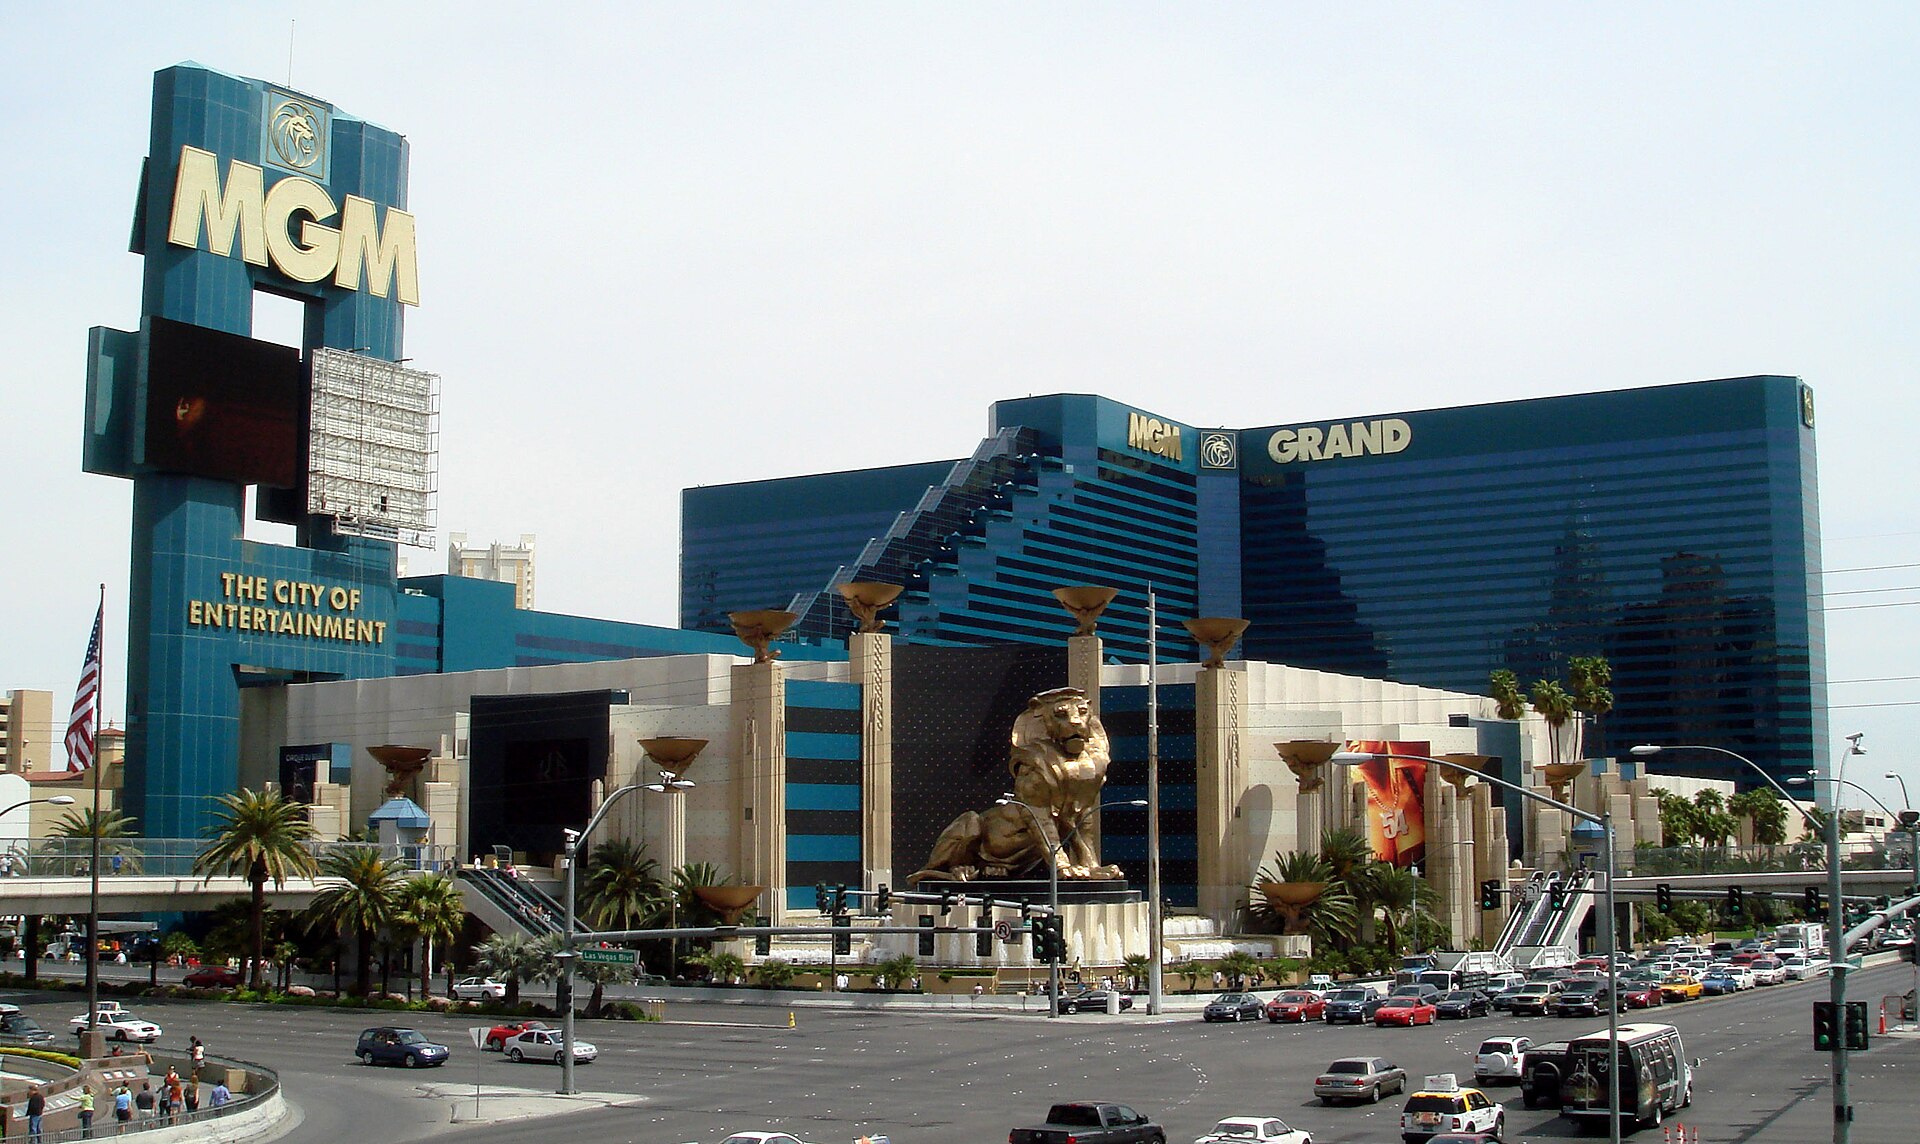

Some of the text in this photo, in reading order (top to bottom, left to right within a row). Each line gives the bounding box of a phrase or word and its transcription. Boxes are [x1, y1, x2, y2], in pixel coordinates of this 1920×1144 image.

[168, 145, 420, 307] MGM
[1128, 412, 1412, 464] MGM GRAND
[221, 572, 361, 611] THE CITY OF
[189, 600, 387, 644] ENTERTAINMENT
[1380, 809, 1409, 839] 54
[584, 952, 634, 963] Las Vegas Blvd
